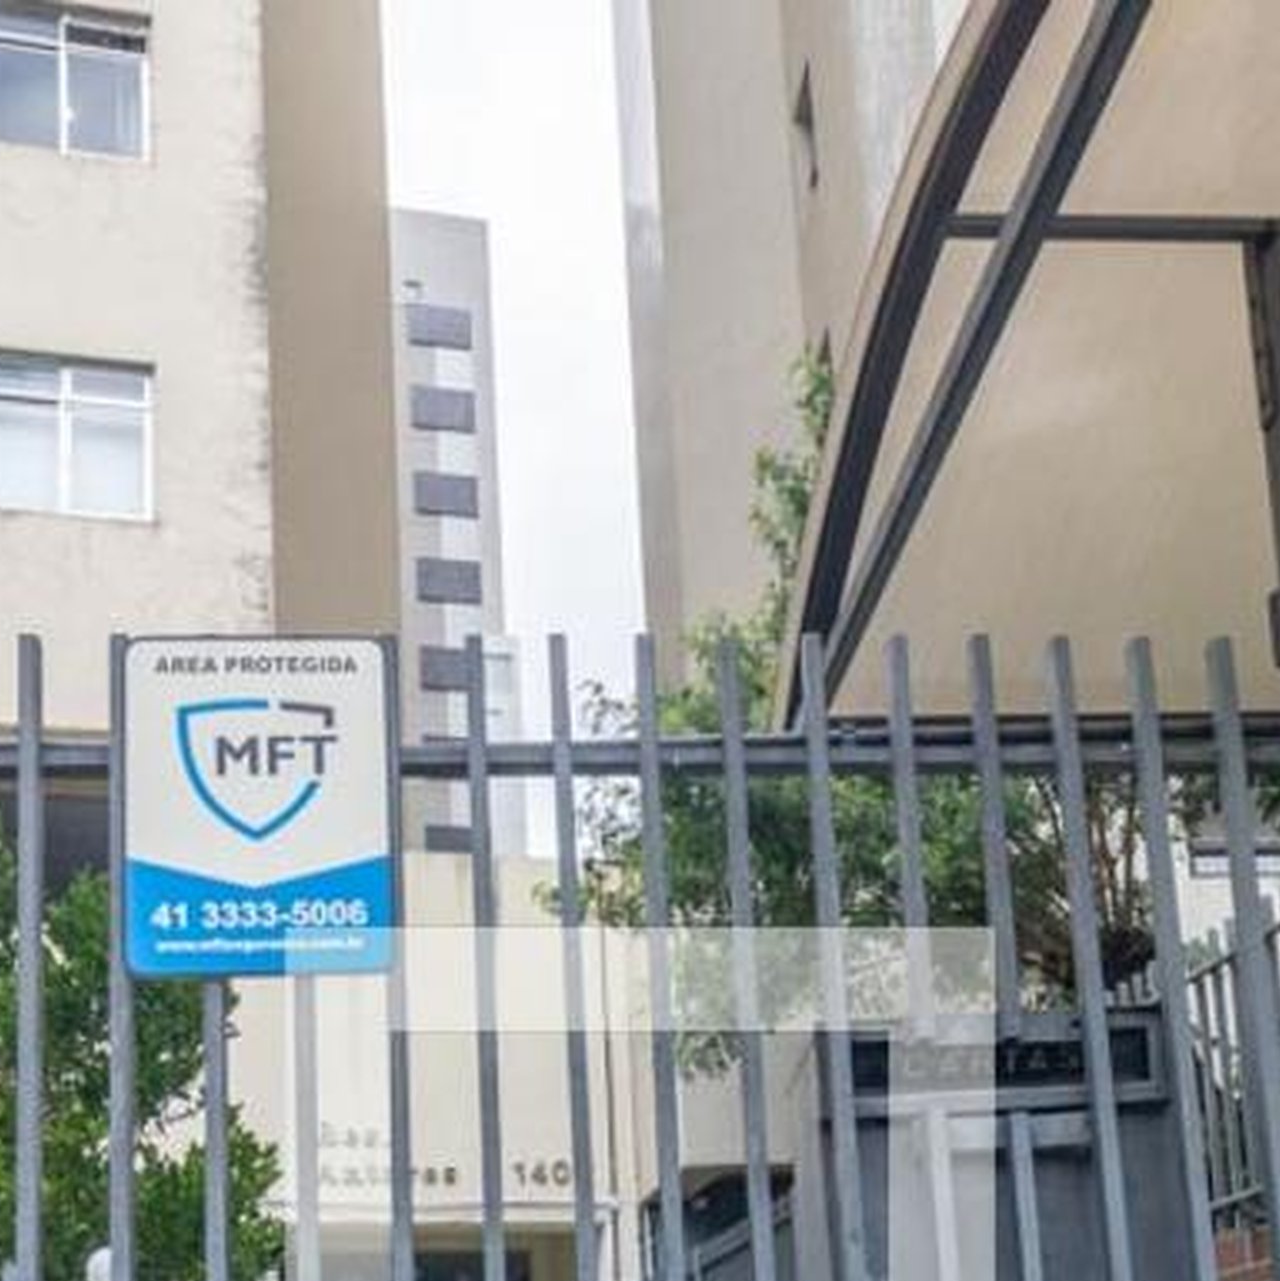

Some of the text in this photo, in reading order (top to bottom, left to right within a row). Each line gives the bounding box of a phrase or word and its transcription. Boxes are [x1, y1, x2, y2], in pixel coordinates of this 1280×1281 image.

[224, 655, 358, 674] PROTEGIDA
[214, 735, 338, 776] MFT
[150, 898, 369, 928] 41 3333-5006
[513, 1158, 571, 1188] 140
